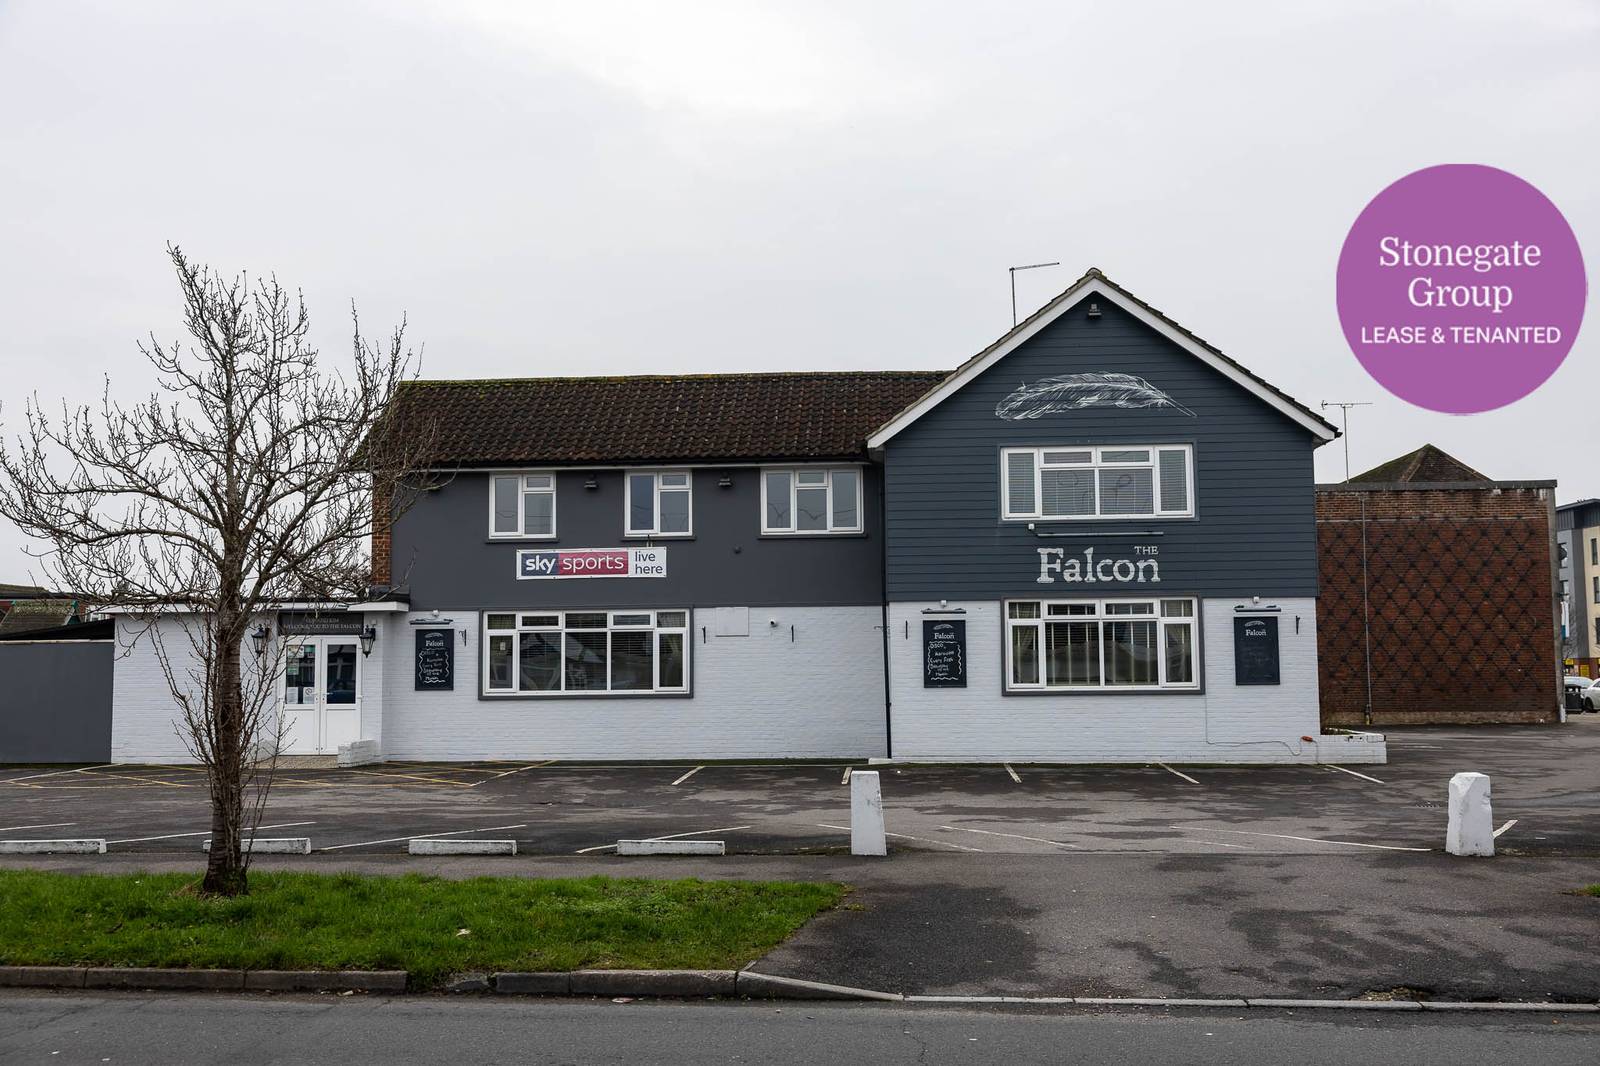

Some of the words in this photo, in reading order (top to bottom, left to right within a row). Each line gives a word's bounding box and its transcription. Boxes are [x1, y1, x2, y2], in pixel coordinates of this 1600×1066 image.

[635, 550, 656, 562] live
[1134, 545, 1159, 555] THE
[525, 554, 557, 574] sky
[562, 554, 625, 573] sports
[635, 563, 664, 575] here
[1036, 546, 1161, 584] Falcon
[934, 632, 955, 640] Falcon
